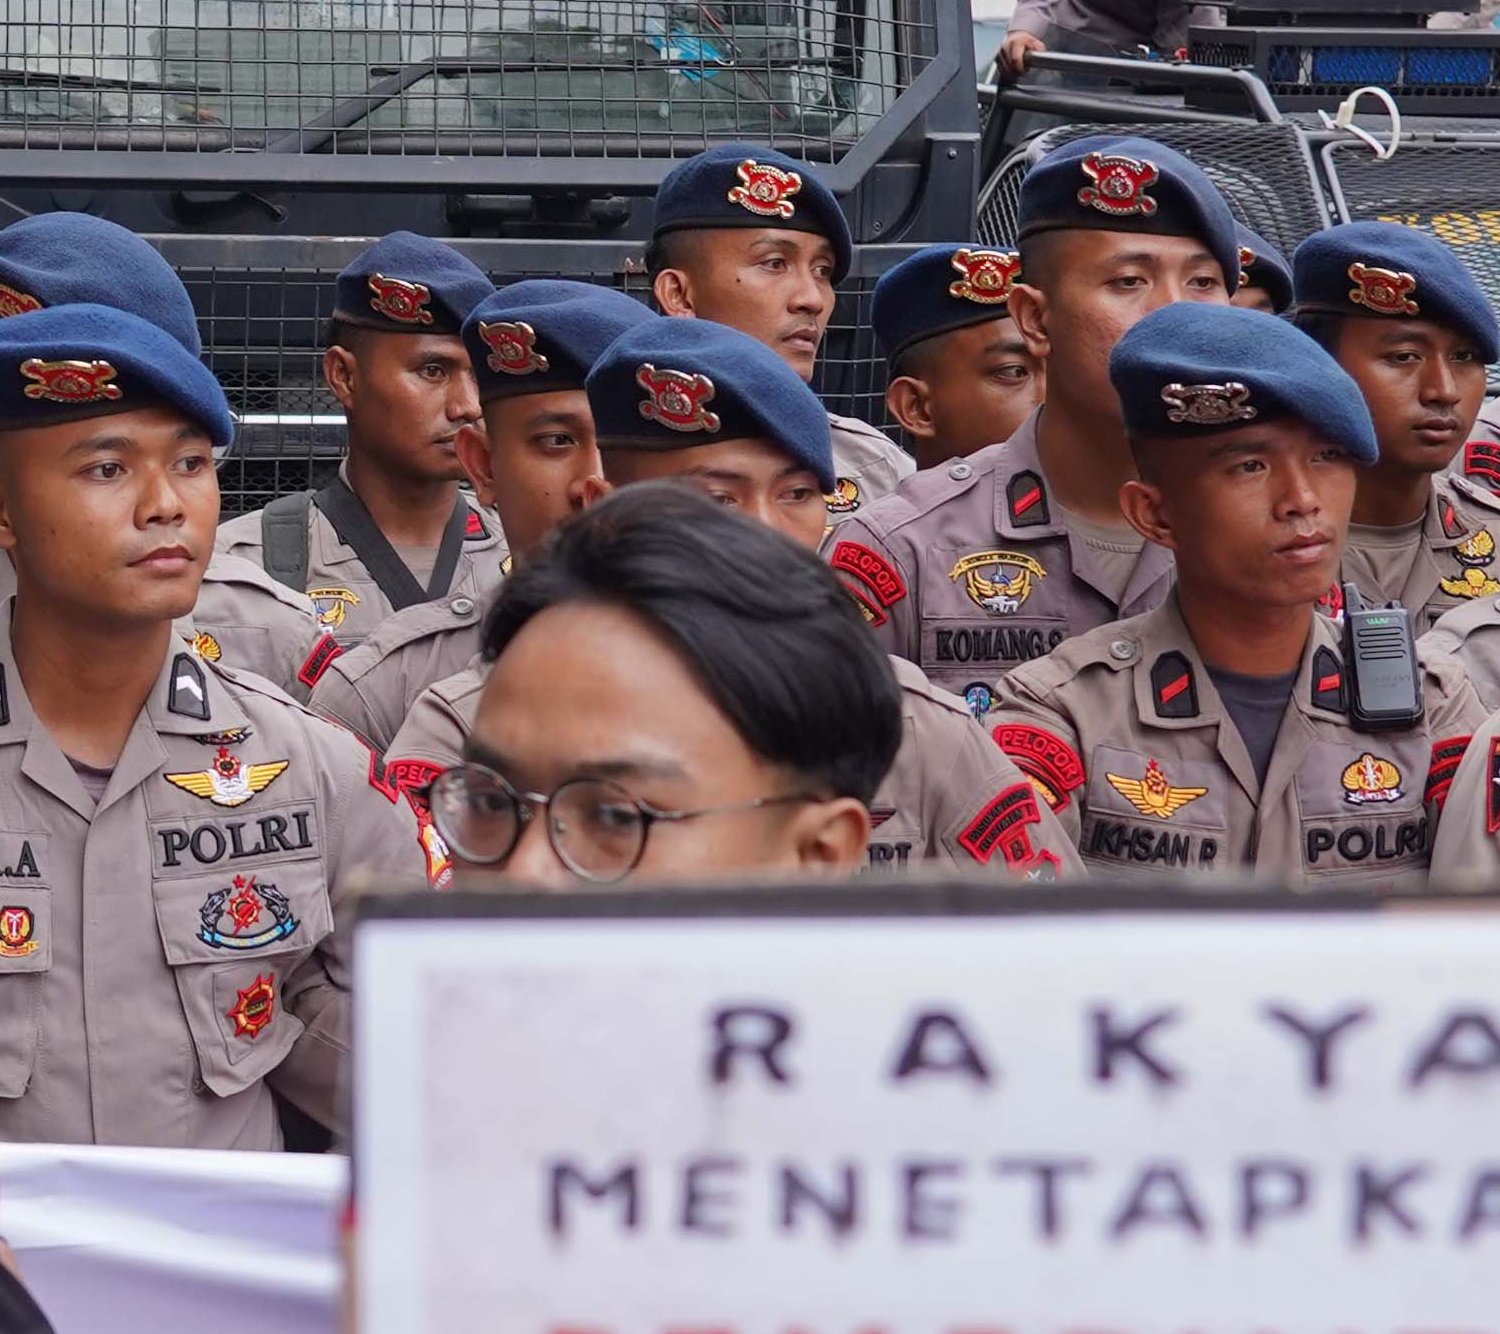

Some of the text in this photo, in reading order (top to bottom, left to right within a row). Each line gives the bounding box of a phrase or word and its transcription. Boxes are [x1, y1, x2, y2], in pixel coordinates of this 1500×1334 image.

[838, 546, 898, 598] PELOPOR
[1002, 729, 1077, 781] PELOPOR
[157, 811, 314, 868] POLRI
[1090, 819, 1189, 868] IKHSAN
[1306, 818, 1427, 864] POLRI
